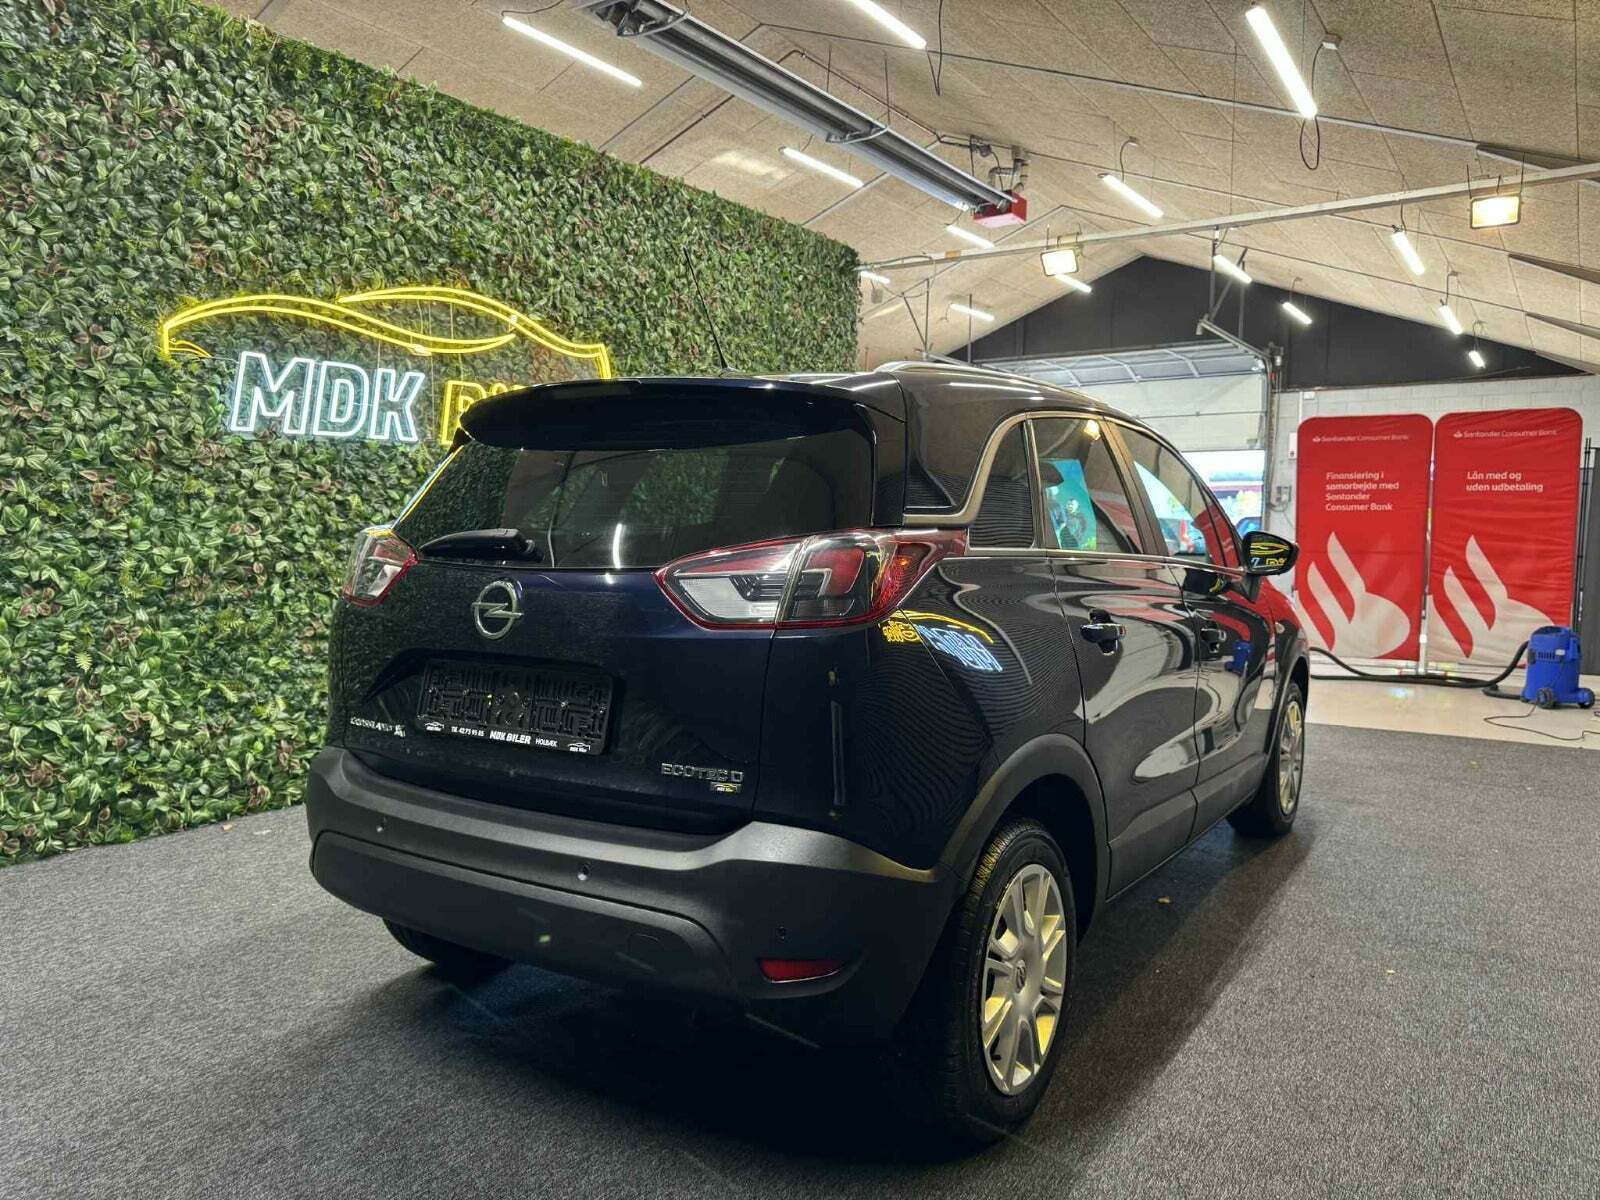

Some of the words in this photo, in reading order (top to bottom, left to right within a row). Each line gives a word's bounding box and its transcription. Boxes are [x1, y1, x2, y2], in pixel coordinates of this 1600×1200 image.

[230, 351, 426, 443] MDK
[1326, 472, 1379, 480] Finansiering
[1467, 471, 1484, 480] Lån
[1486, 471, 1507, 480] med
[1509, 472, 1522, 481] og
[1326, 482, 1377, 491] samarbejde
[1379, 481, 1400, 490] med
[1466, 483, 1490, 492] uden
[1491, 482, 1544, 493] udbetaling
[1325, 493, 1370, 501] Santander
[1325, 503, 1369, 511] Consumer
[1370, 503, 1393, 511] Bank
[506, 733, 532, 744] BILER
